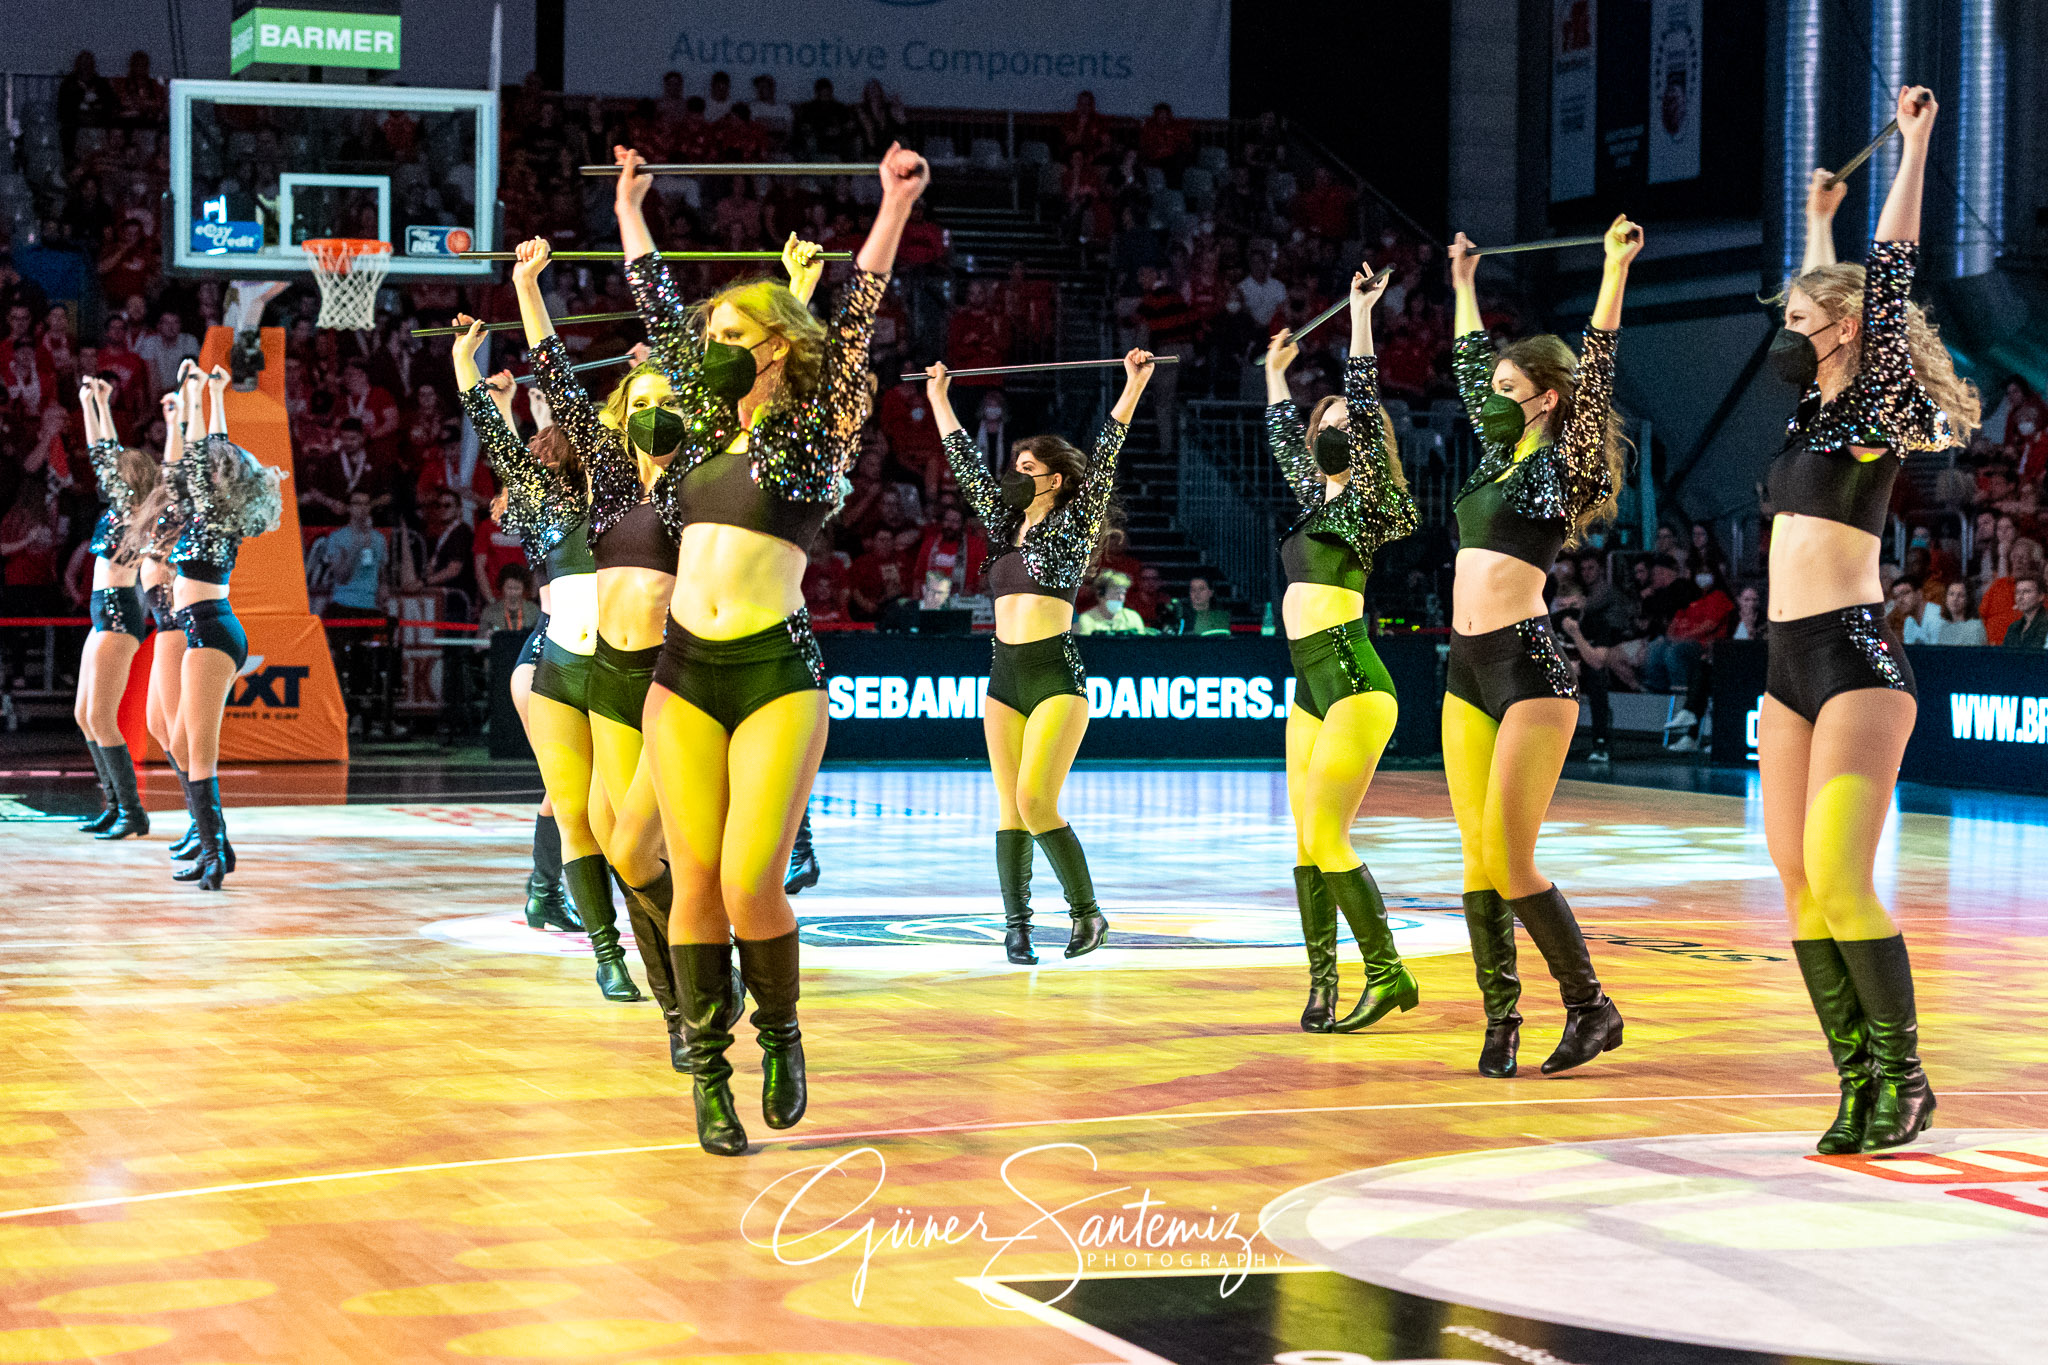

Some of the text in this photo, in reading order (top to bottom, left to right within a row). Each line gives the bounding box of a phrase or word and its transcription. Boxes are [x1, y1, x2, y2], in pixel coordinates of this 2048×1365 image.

[260, 24, 394, 53] BARMER
[671, 32, 1132, 81] Automotive Components
